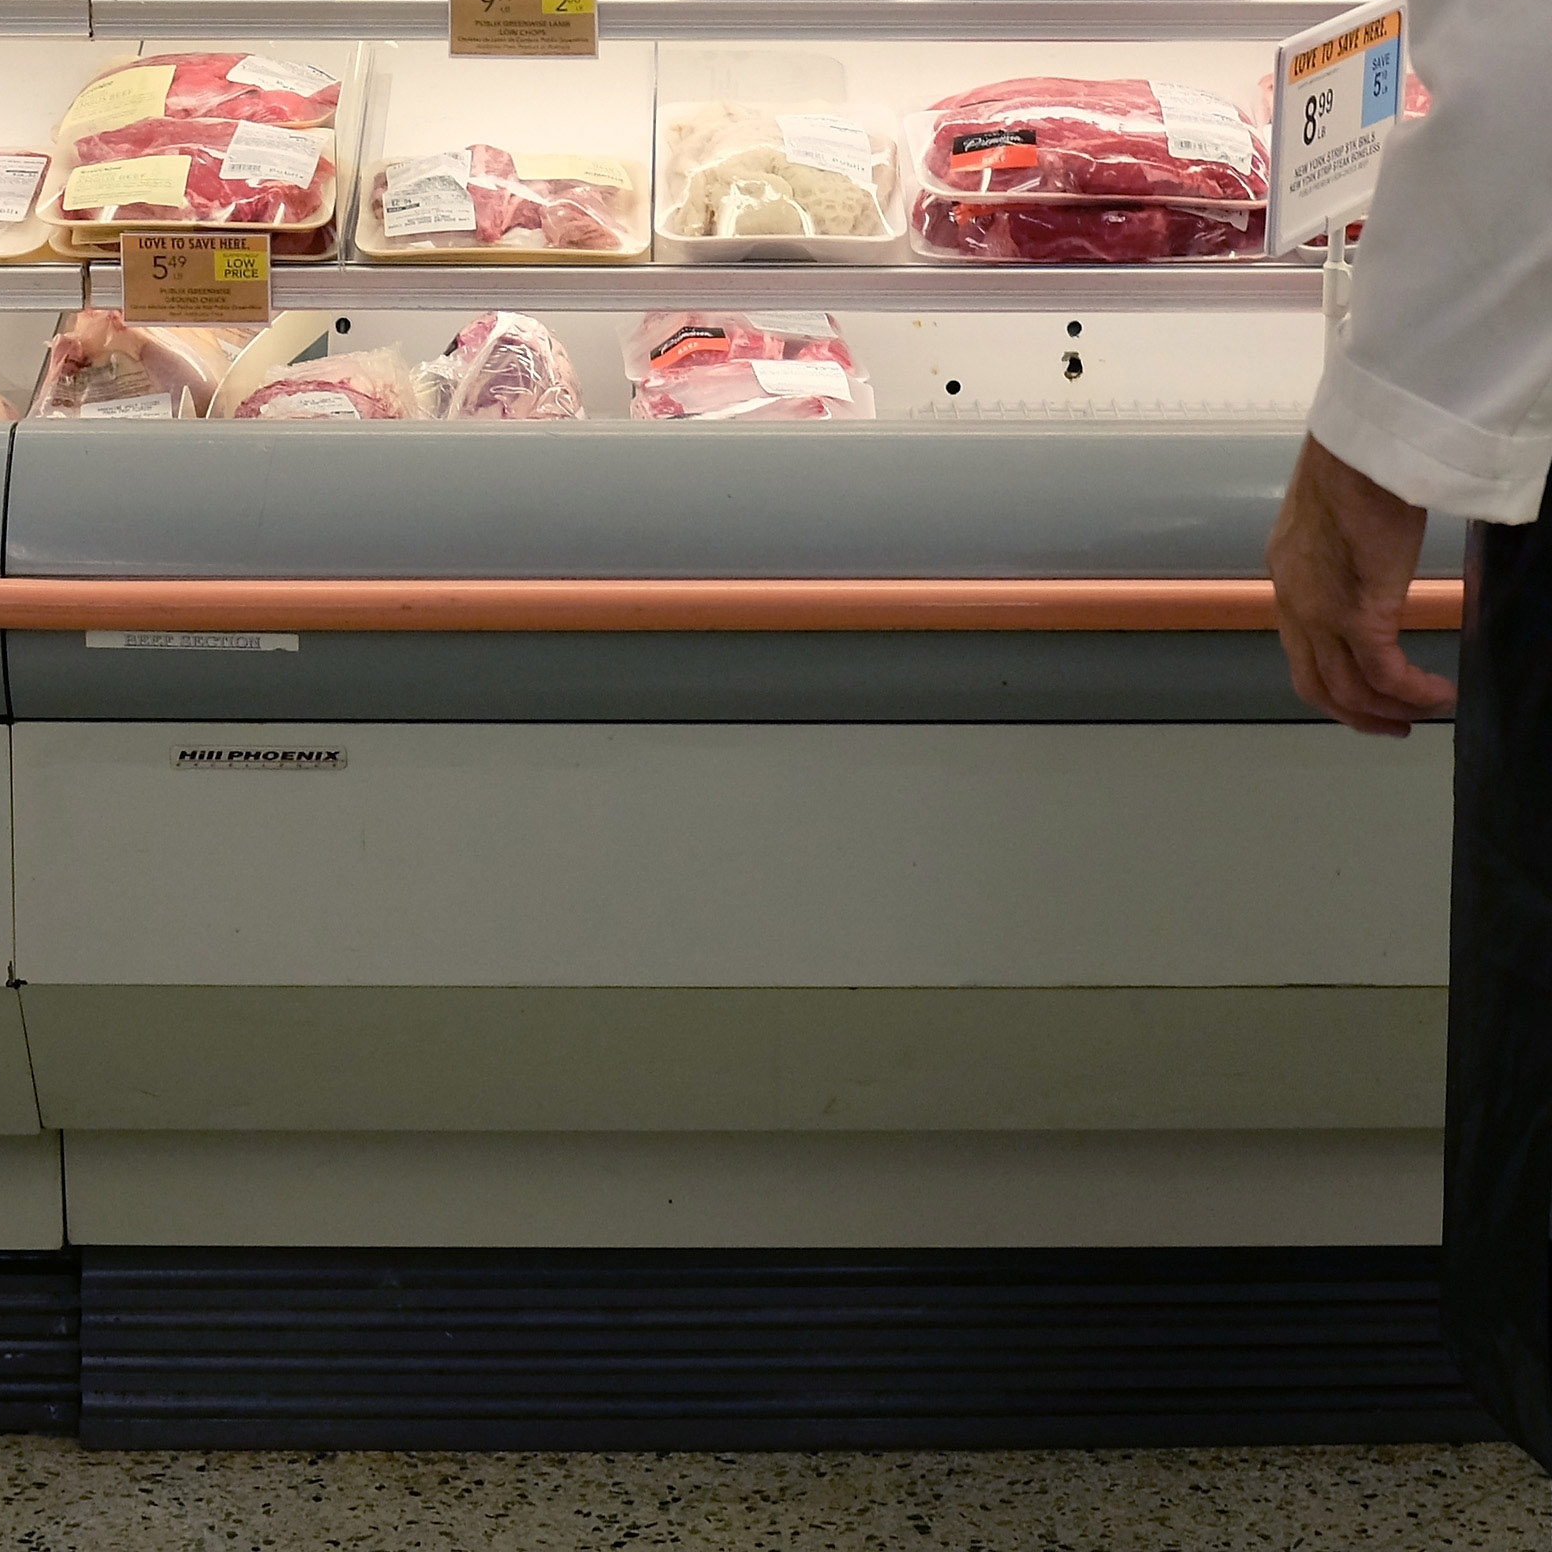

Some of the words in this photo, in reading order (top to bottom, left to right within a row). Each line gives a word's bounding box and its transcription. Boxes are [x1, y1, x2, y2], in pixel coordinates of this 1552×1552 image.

[1294, 49, 1317, 76] LOVE
[1321, 40, 1334, 64] TO
[1337, 27, 1360, 56] SAVE
[1363, 17, 1387, 44] HERE.
[1372, 53, 1390, 70] SAVE
[1317, 125, 1326, 140] LB
[138, 238, 166, 249] LOVE
[171, 238, 185, 249] TO
[189, 238, 216, 249] SAVE
[220, 238, 250, 249] HERE.
[227, 258, 255, 268] LOW
[224, 268, 259, 278] PRICE
[124, 634, 174, 646] BEEF
[179, 635, 261, 648] SECTION
[178, 750, 223, 760] Hill
[227, 750, 340, 761] PHOENIX
